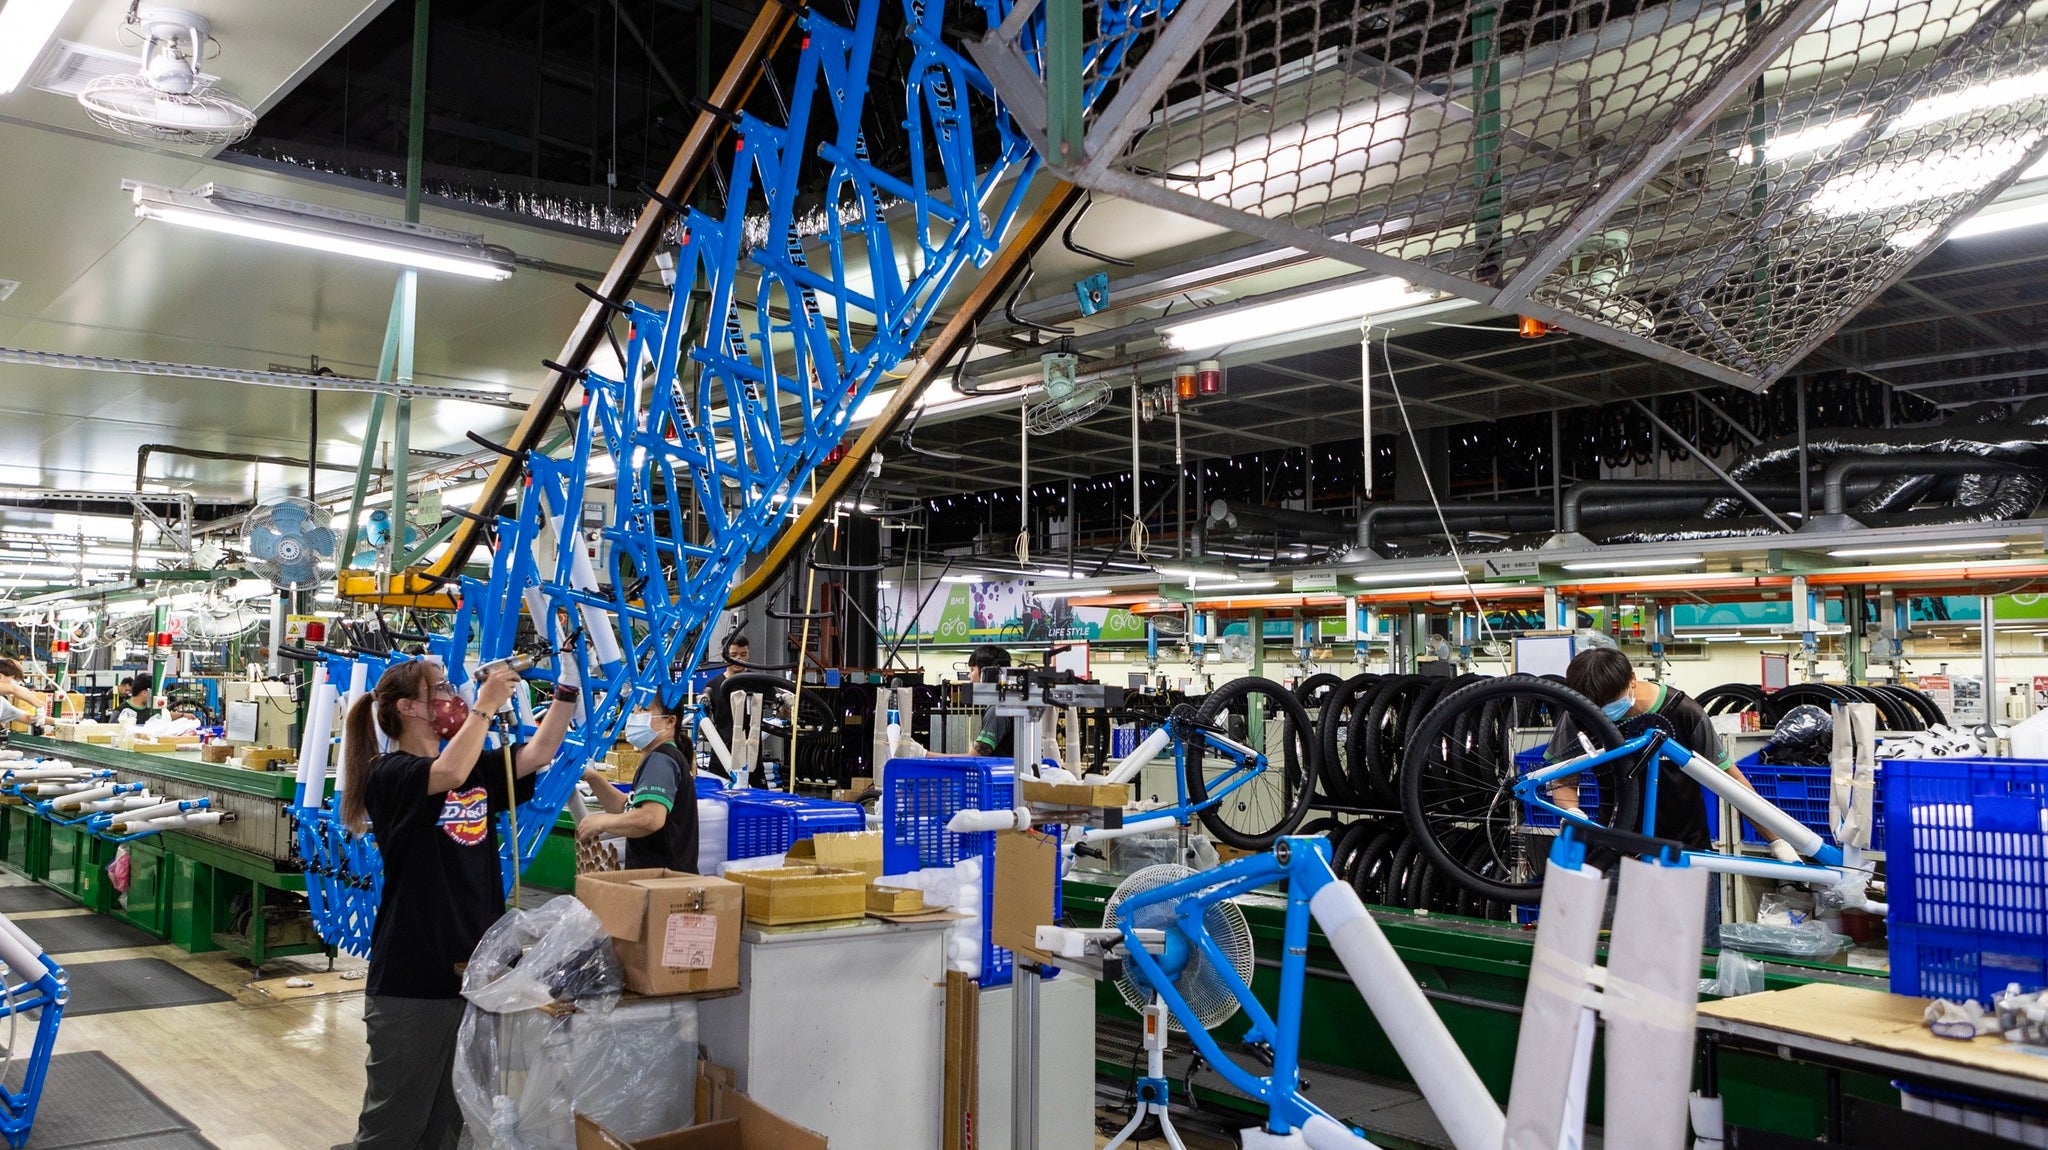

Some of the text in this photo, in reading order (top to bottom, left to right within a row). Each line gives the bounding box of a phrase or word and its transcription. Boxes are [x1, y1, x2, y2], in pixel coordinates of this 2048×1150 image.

[950, 596, 965, 606] BMX
[1048, 627, 1090, 637] LIFE STYLE
